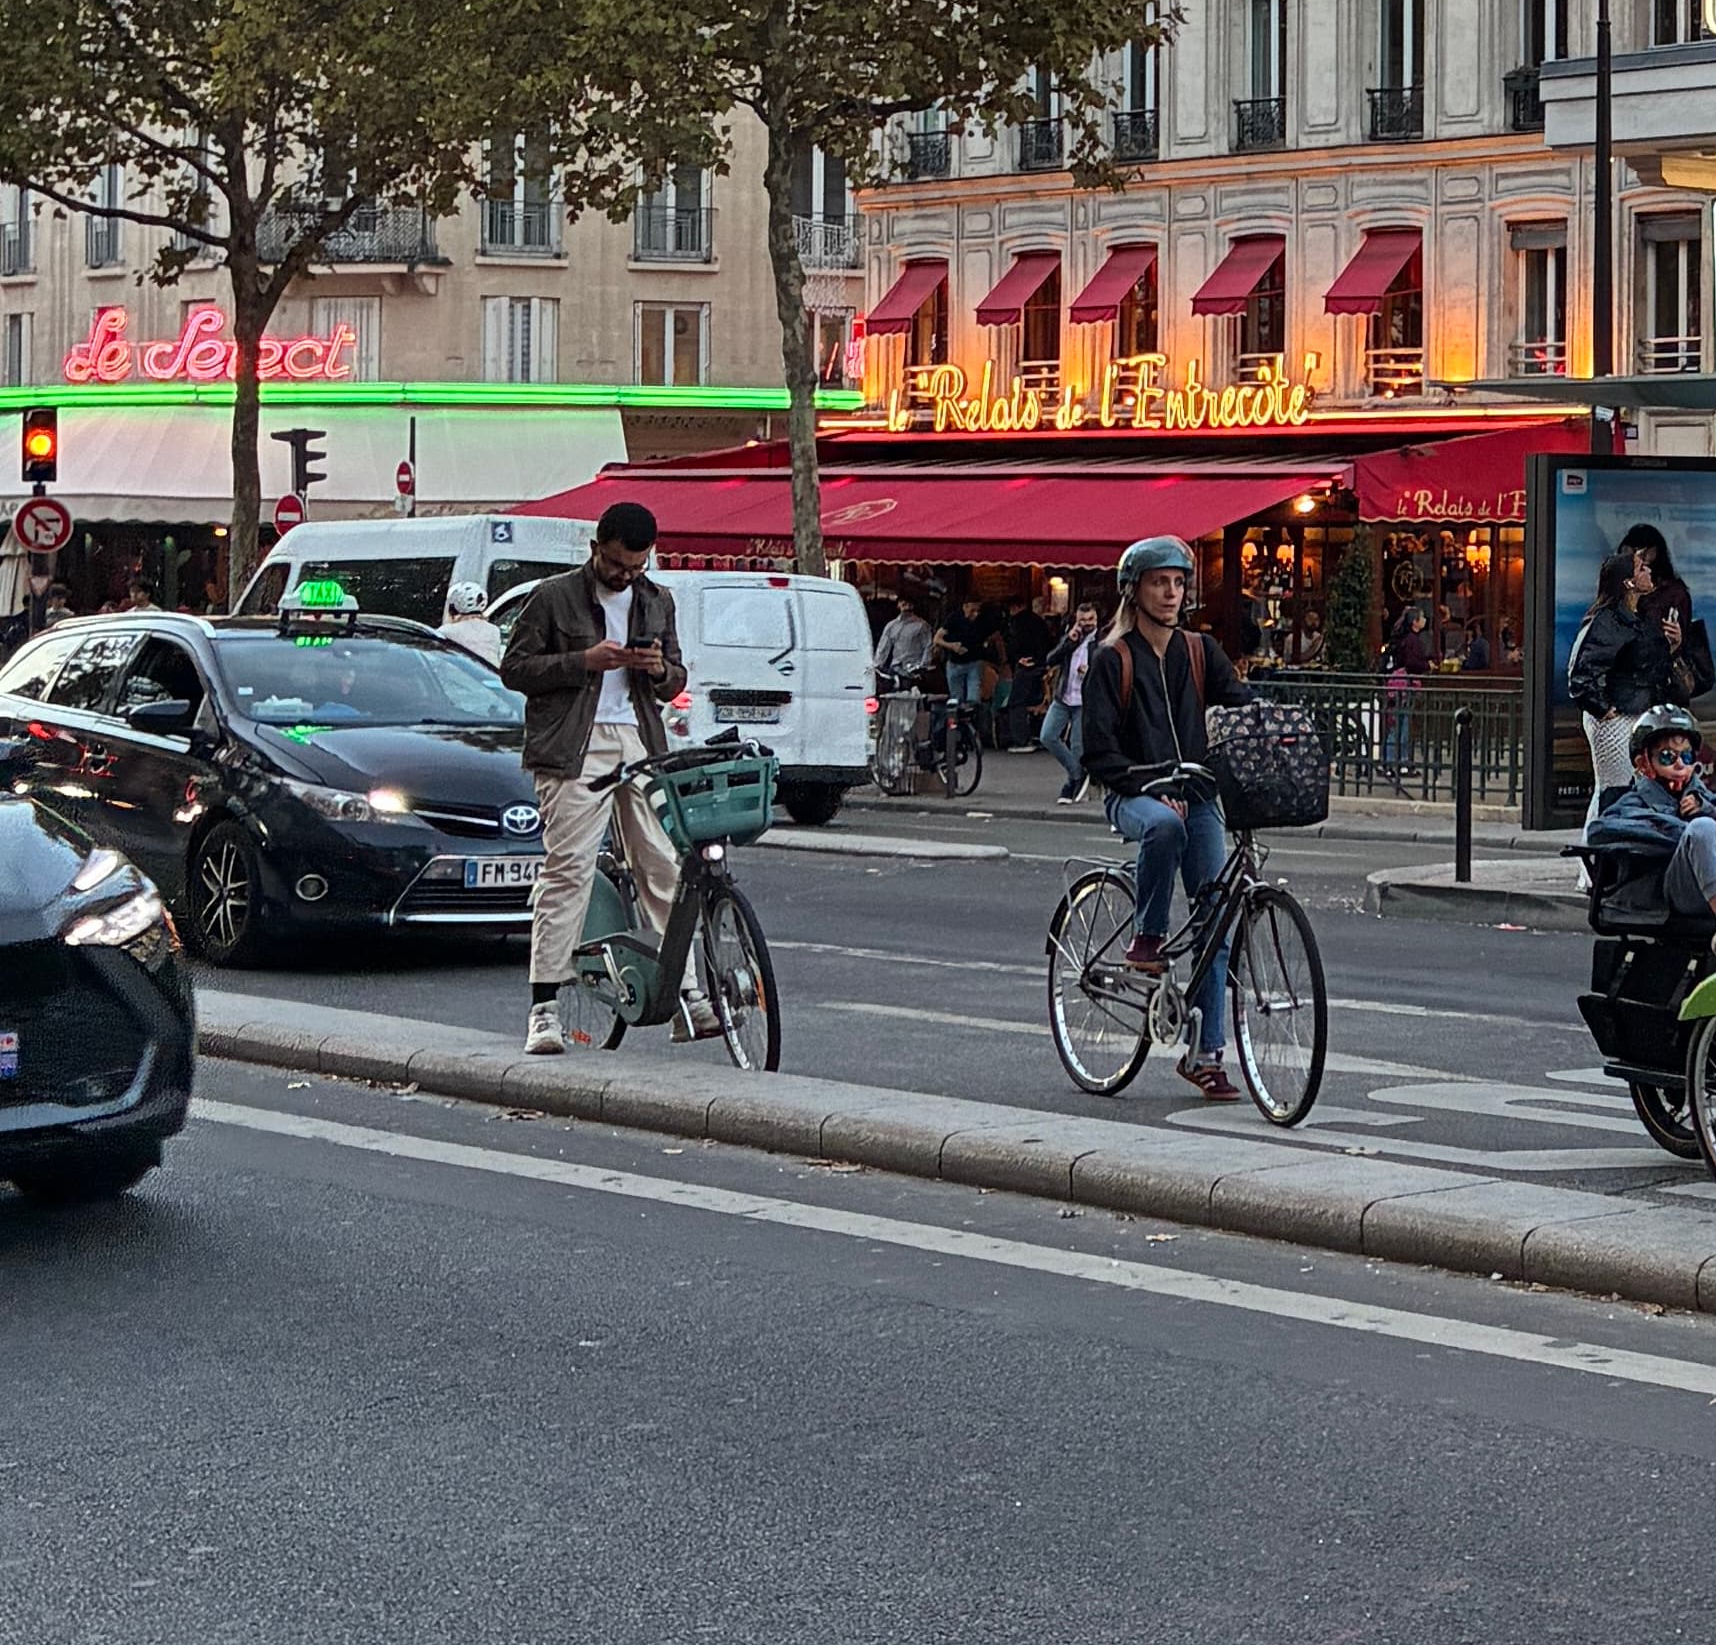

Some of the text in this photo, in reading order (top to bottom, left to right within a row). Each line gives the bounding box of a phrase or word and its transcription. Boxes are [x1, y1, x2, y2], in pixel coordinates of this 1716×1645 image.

[66, 305, 355, 382] Le Seect
[889, 389, 909, 431] le
[1056, 385, 1085, 430] de
[308, 584, 338, 601] TAXI
